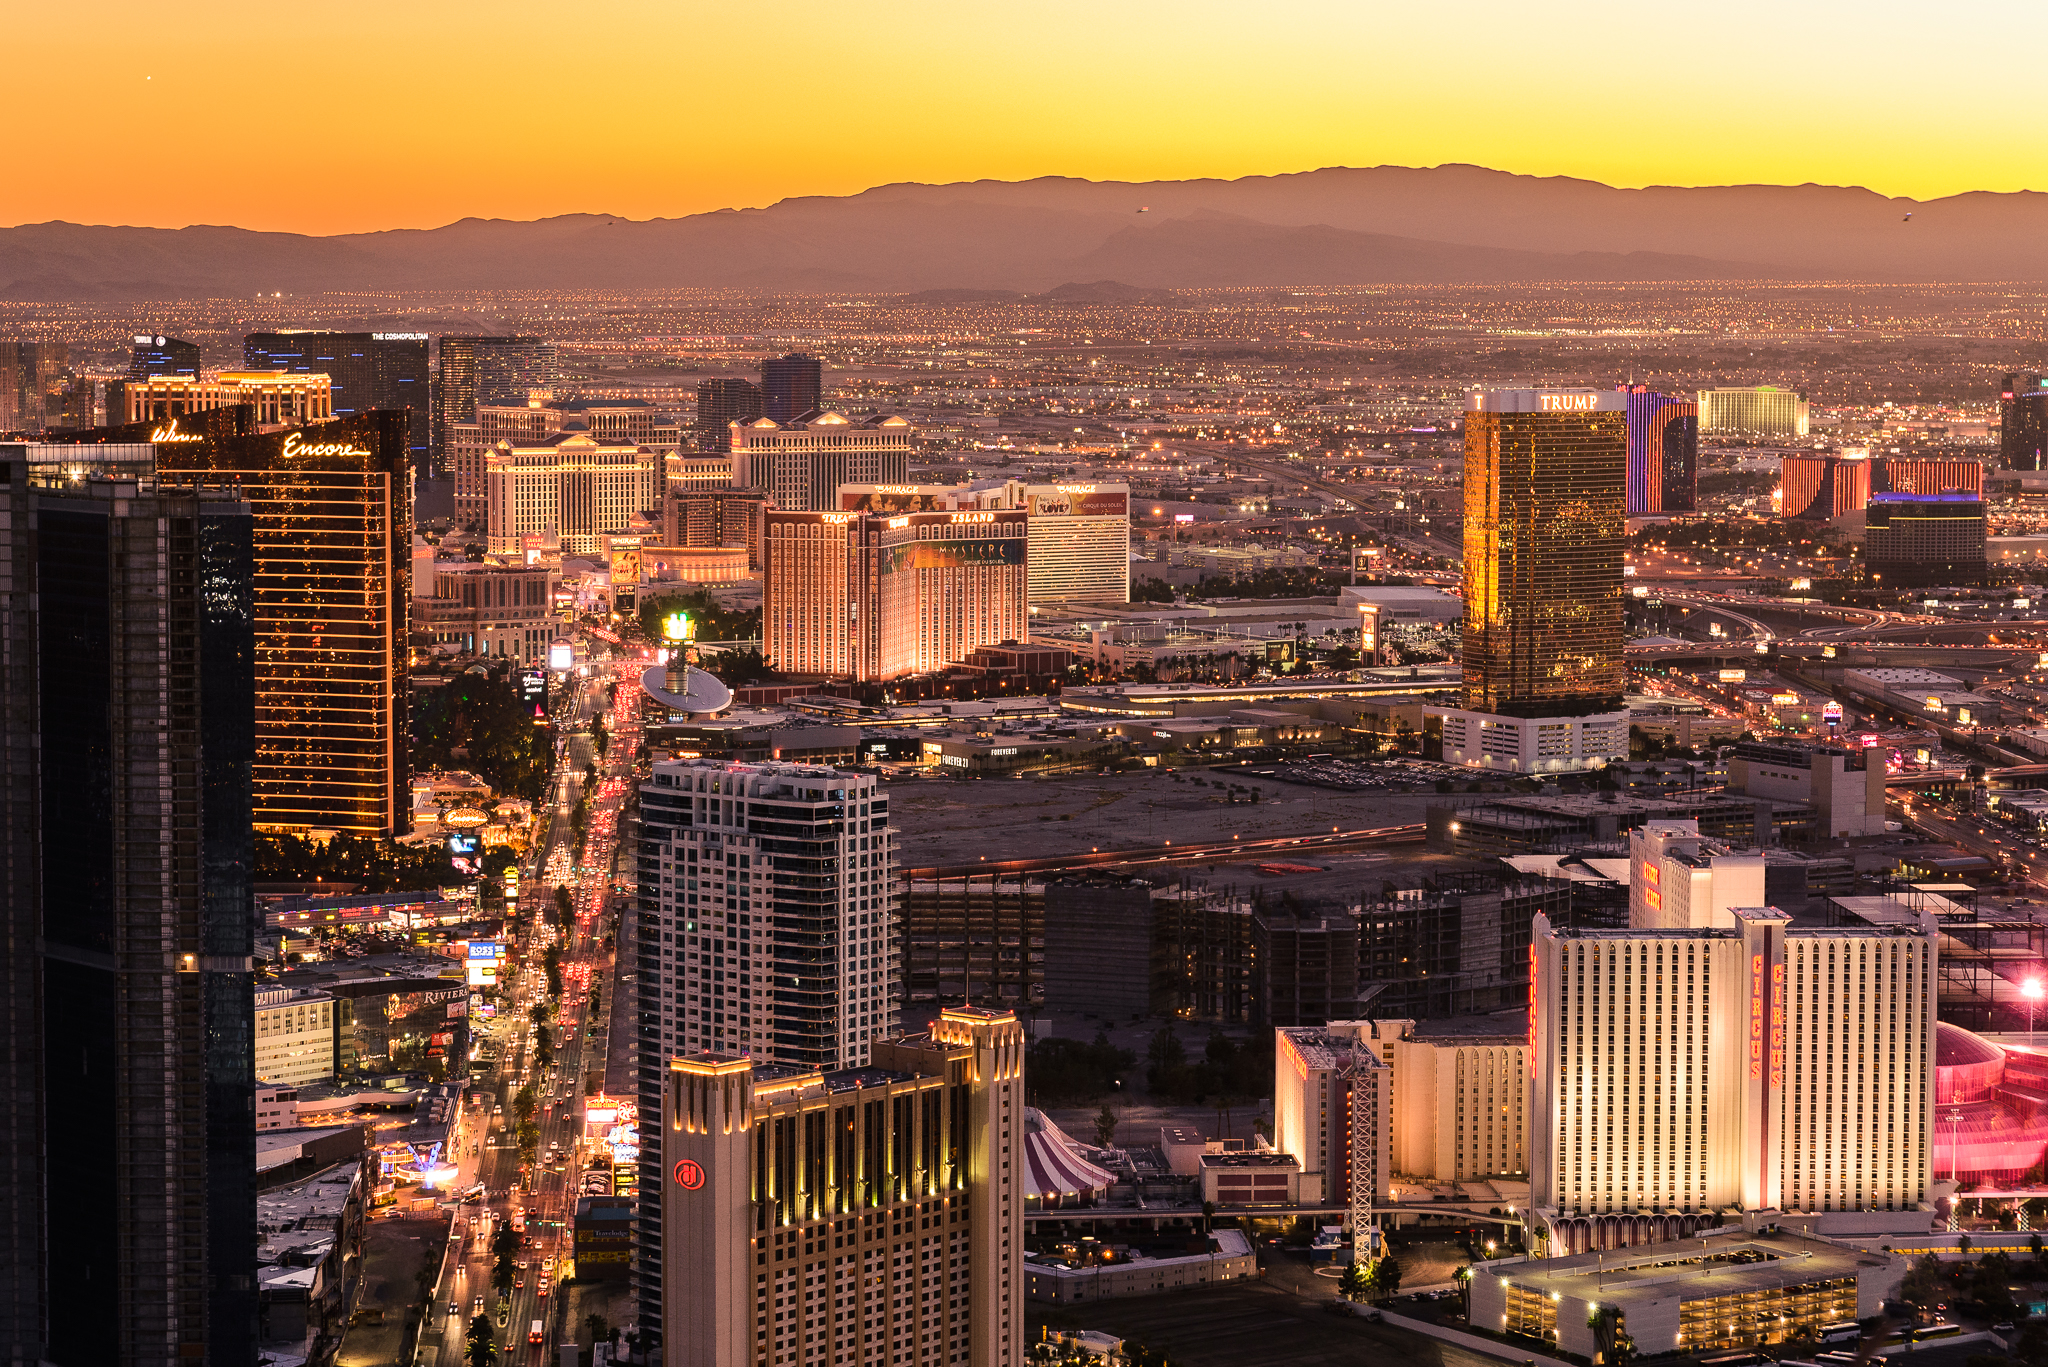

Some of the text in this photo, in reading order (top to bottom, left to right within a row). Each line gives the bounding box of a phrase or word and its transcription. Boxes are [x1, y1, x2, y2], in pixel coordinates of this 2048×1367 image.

[1541, 395, 1598, 410] TRUMP
[283, 432, 371, 457] Encore
[878, 486, 919, 494] MIRAGE
[1060, 485, 1096, 494] MIRAGE
[951, 513, 994, 523] ISLAND
[942, 755, 969, 768] FOREVER 21
[424, 988, 468, 1005] RIVIERA
[1750, 954, 1762, 1080] CIRCUS
[1771, 963, 1783, 1090] CIRCUS
[595, 1230, 629, 1238] Travelodge
